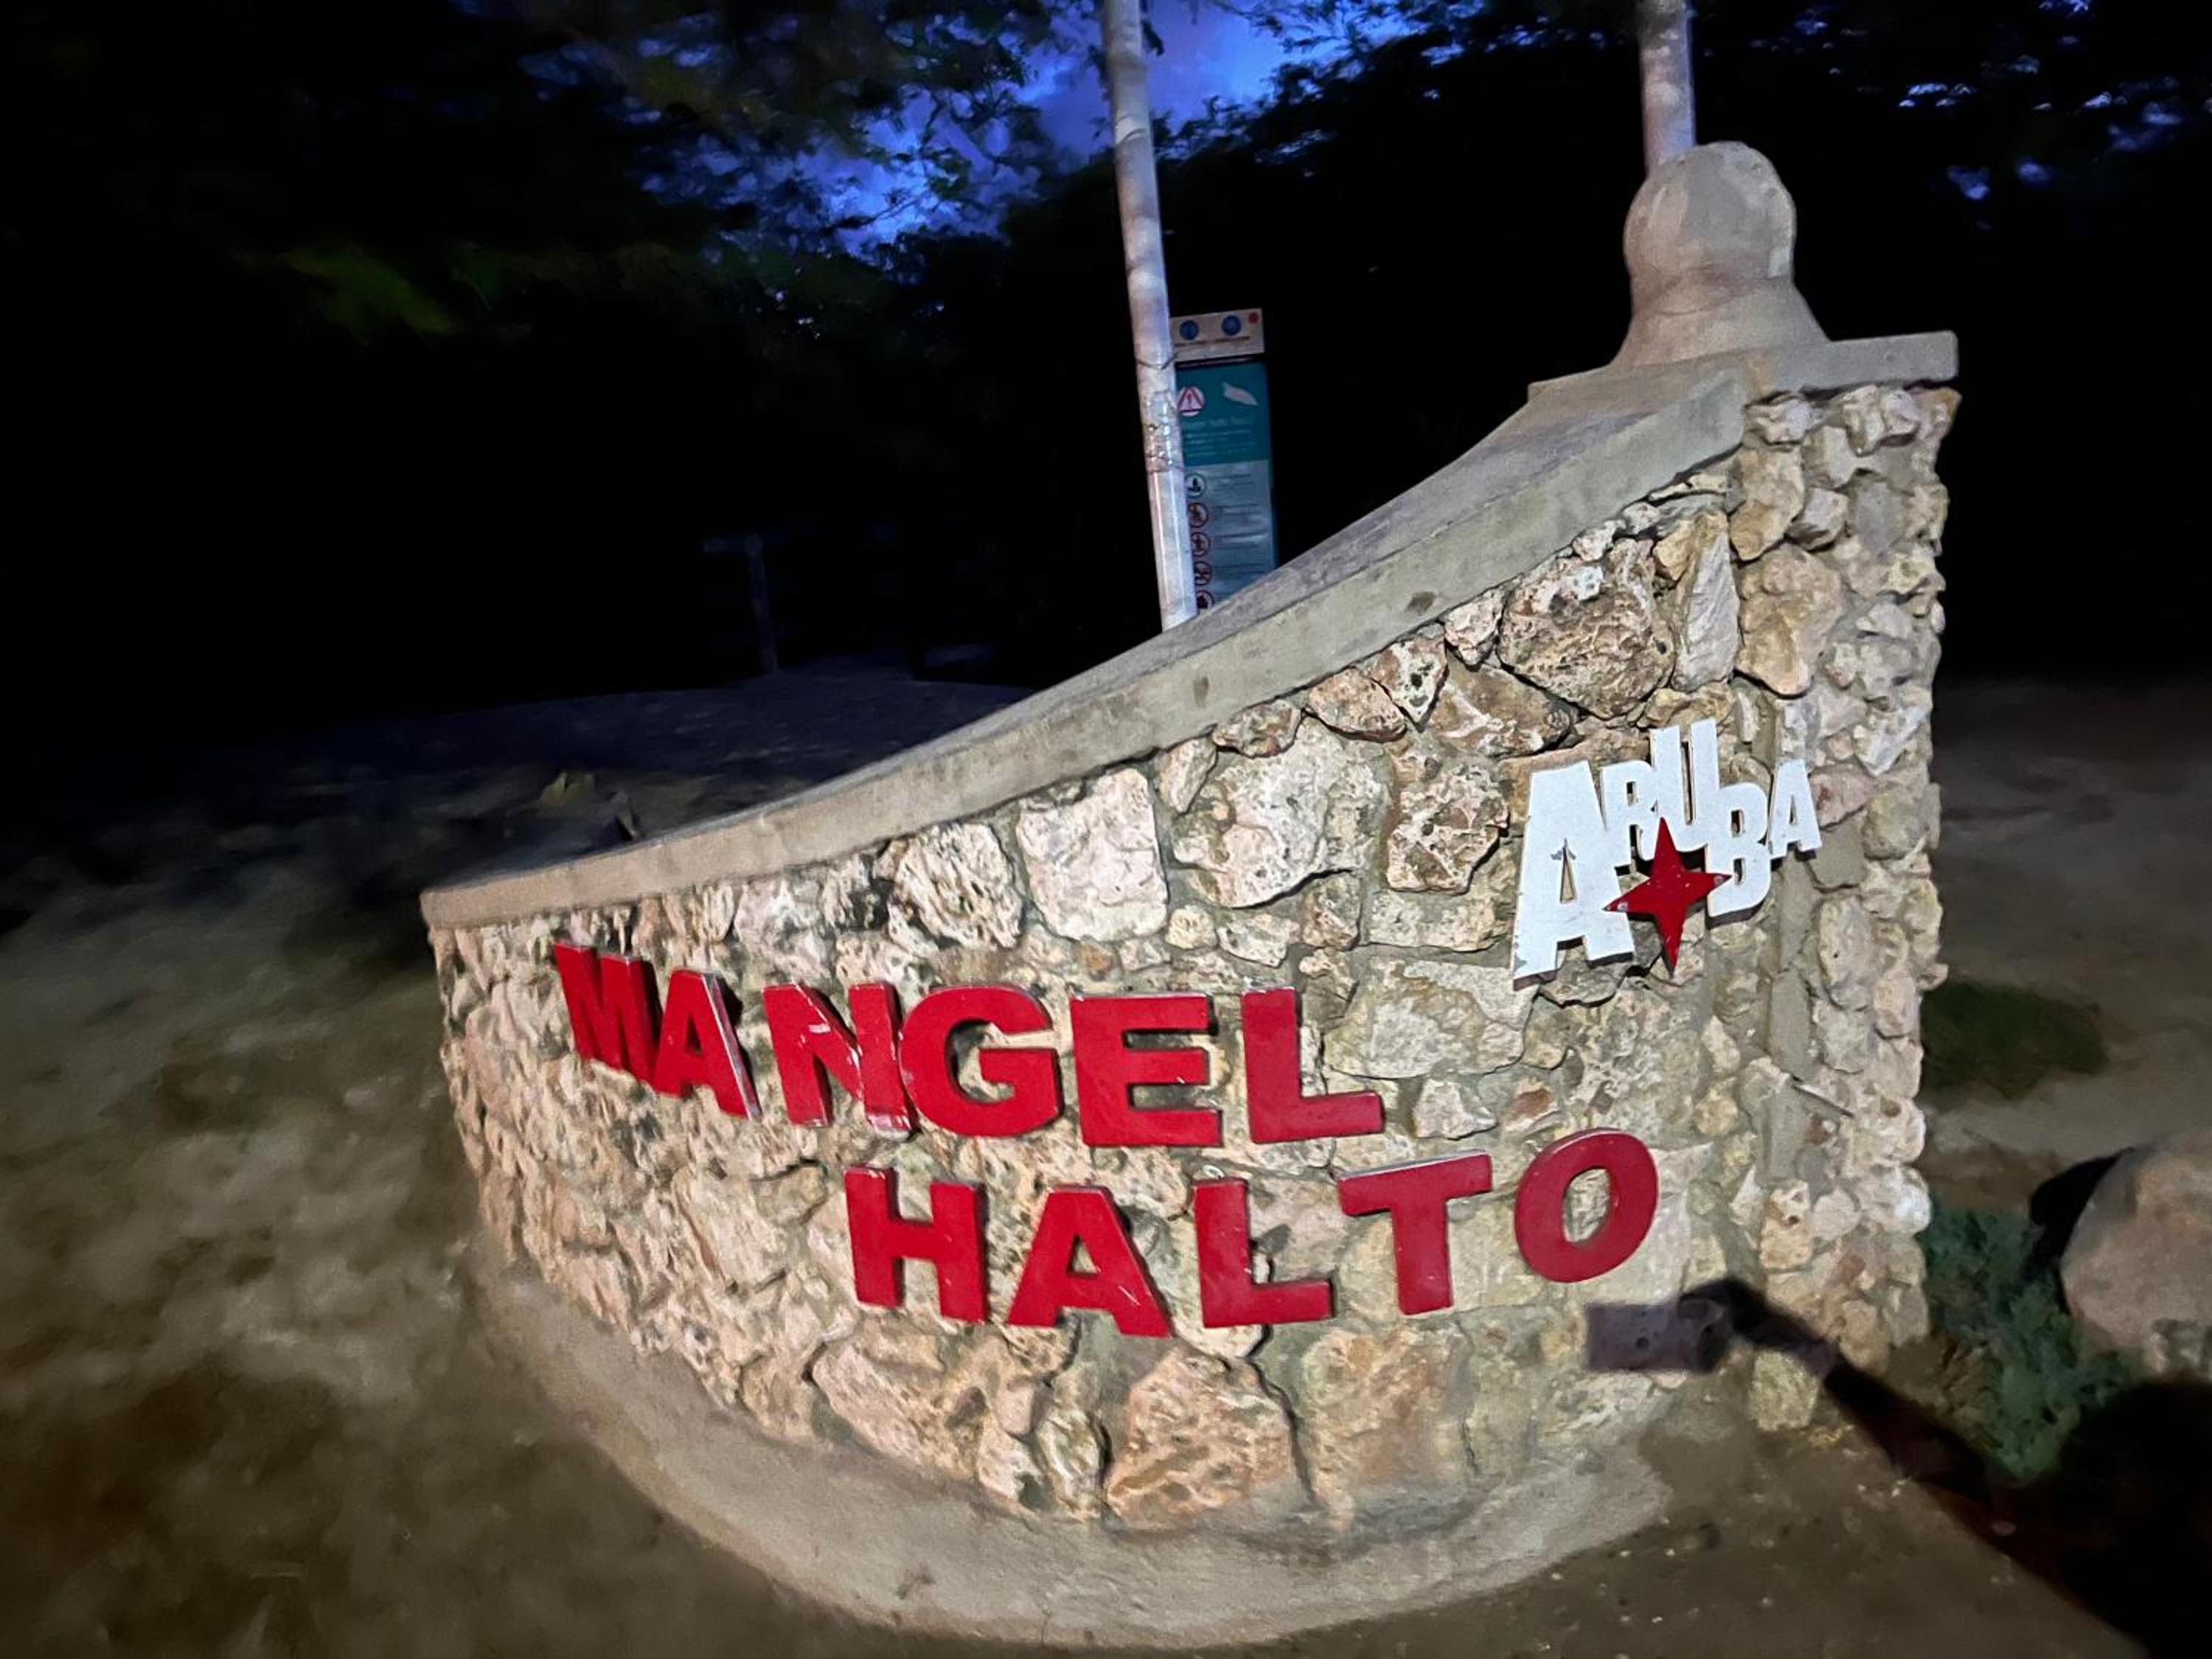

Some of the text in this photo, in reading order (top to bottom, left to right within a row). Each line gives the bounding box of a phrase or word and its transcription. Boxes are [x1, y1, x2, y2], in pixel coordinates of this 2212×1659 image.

[1513, 718, 1823, 981] ARUBA
[553, 941, 1385, 1147] MANGEL
[844, 1128, 1659, 1339] HALTO
